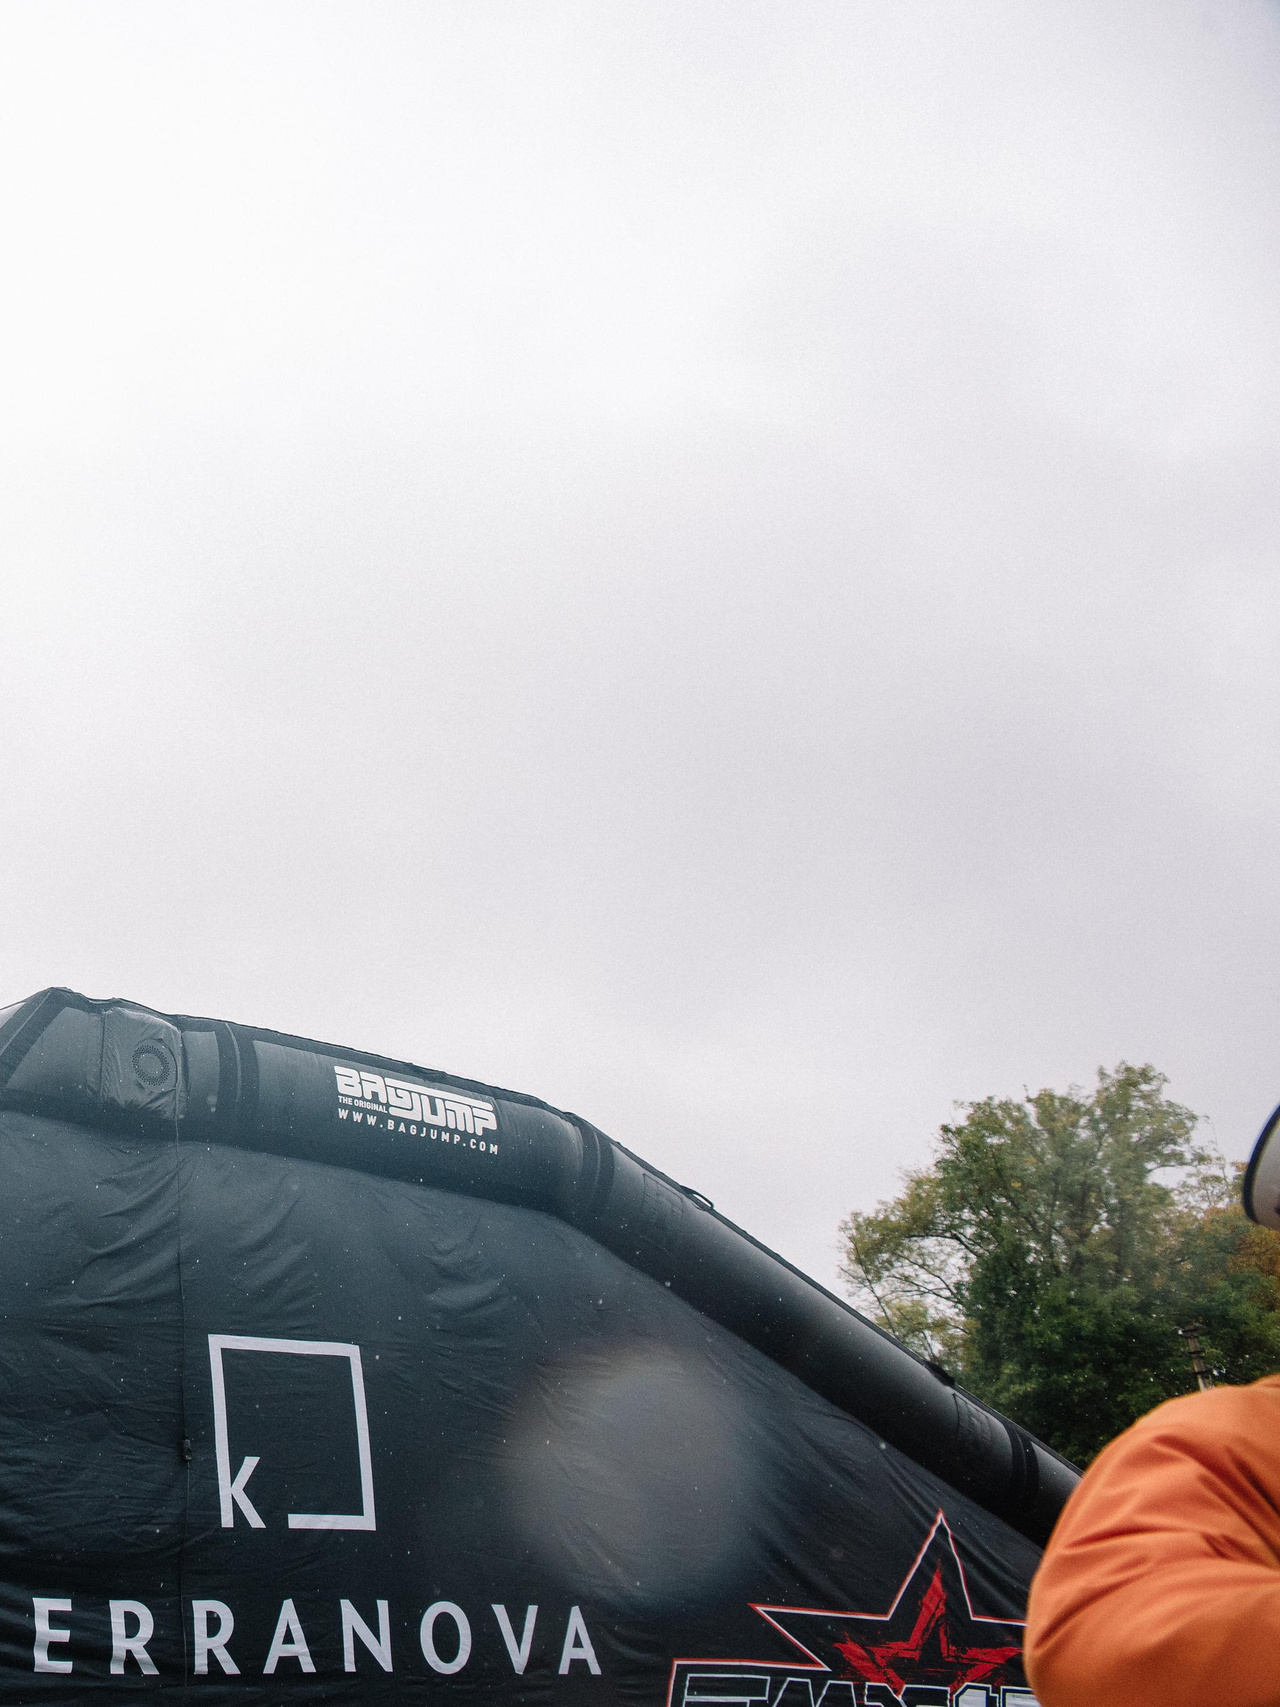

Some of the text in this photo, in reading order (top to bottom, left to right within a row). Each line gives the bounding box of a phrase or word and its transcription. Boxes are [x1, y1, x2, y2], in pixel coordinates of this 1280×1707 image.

[333, 1065, 498, 1136] BAGJUMP
[337, 1095, 388, 1114] THE ORIGINAL
[337, 1108, 499, 1155] WWW.BAGJUMP.COM
